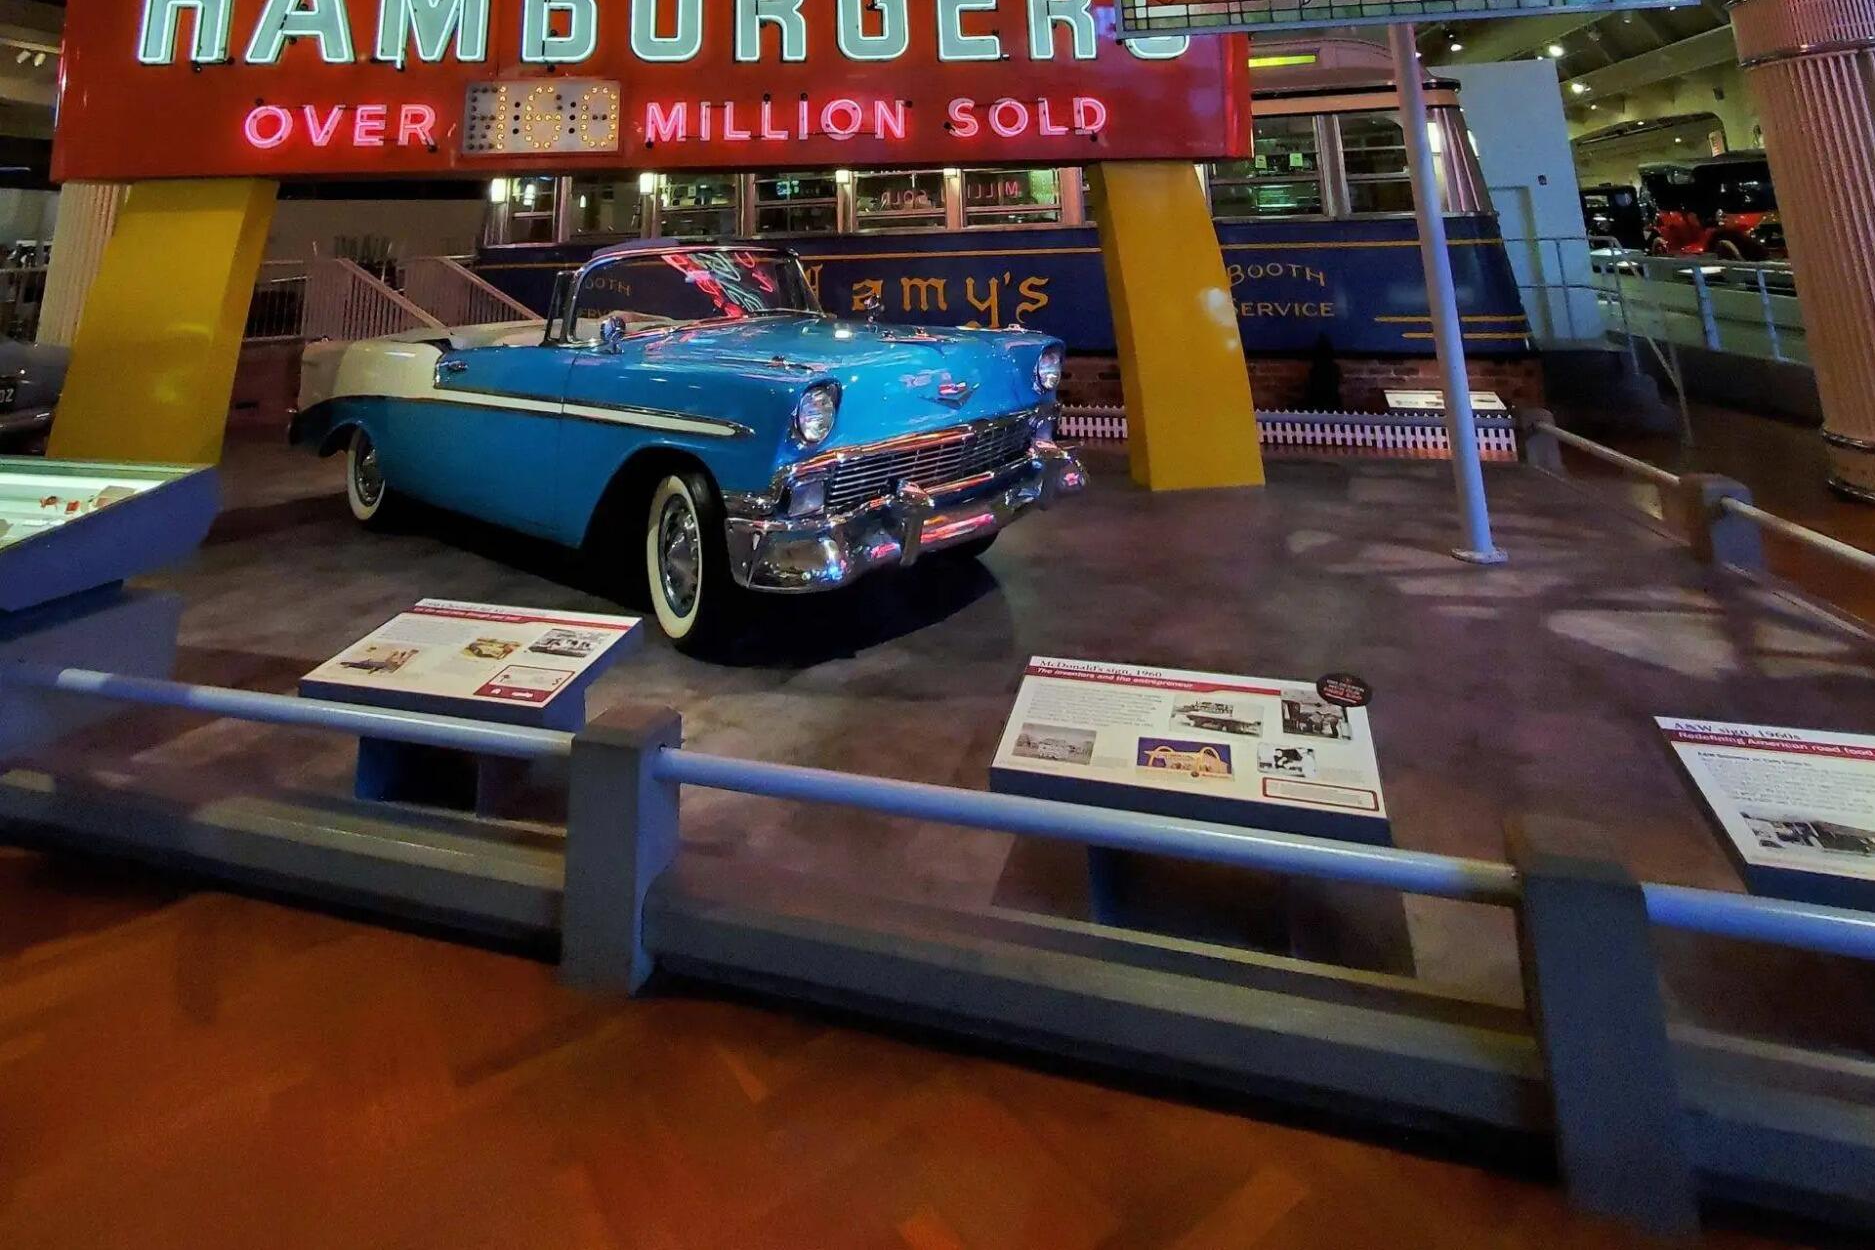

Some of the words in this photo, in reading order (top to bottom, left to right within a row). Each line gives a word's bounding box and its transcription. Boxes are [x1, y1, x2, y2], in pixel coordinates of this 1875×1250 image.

[244, 103, 437, 149] OVER
[645, 99, 908, 142] MILLION
[947, 97, 1108, 139] SOLD
[1227, 262, 1326, 287] BOOTH
[1037, 666, 1053, 675] The
[1054, 668, 1095, 680] inventors
[1097, 673, 1115, 681] and
[1116, 675, 1132, 683] the
[1133, 677, 1194, 689] entrepreneur
[1678, 731, 1745, 746] Redefining
[1747, 738, 1809, 751] American
[1811, 743, 1841, 754] road
[1844, 746, 1875, 757] food
